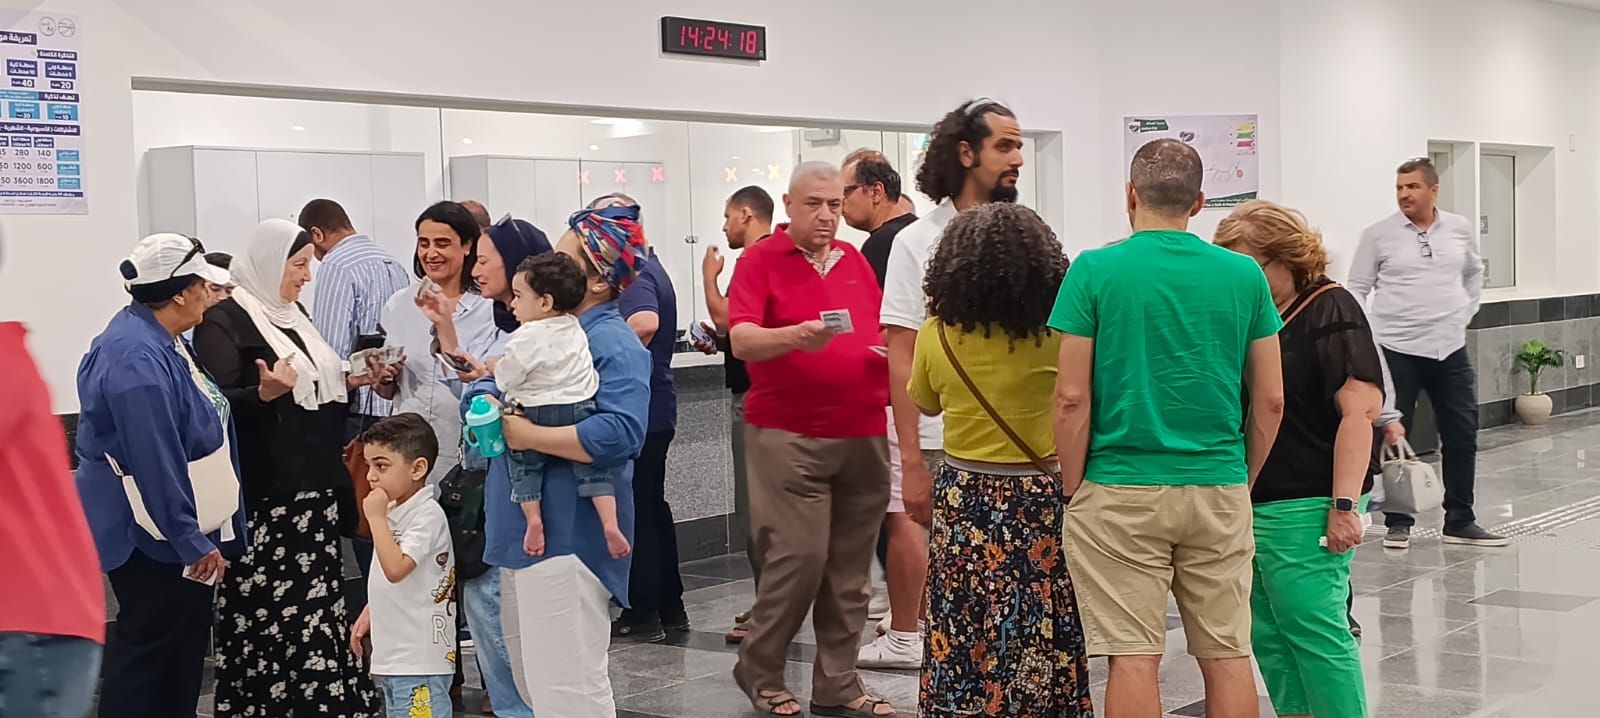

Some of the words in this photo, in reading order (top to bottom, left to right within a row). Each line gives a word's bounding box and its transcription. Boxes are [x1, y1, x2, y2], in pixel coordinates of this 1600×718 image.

[680, 25, 758, 55] 14:24:18
[22, 79, 33, 87] 40
[61, 81, 72, 89] 20
[37, 149, 51, 157] 140
[13, 162, 32, 170] 1200
[13, 176, 33, 185] 3600
[36, 177, 55, 185] 1800
[432, 614, 450, 647] R
